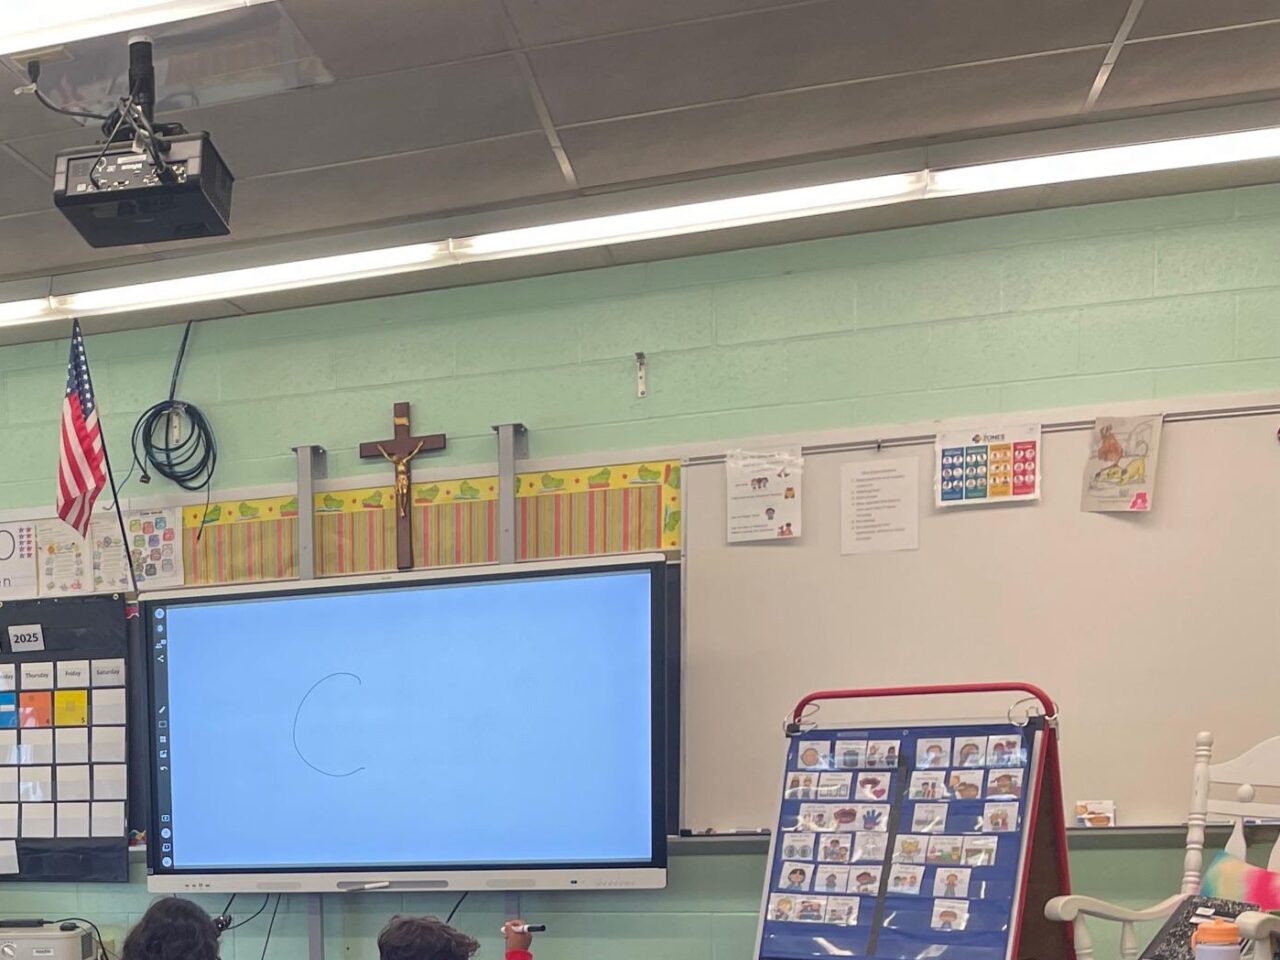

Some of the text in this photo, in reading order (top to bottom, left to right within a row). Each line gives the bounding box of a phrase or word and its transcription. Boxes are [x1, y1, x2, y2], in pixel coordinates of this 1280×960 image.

[13, 633, 39, 645] 2025
[65, 670, 81, 678] Friday
[96, 668, 120, 677] Saturday
[293, 672, 366, 777] C
